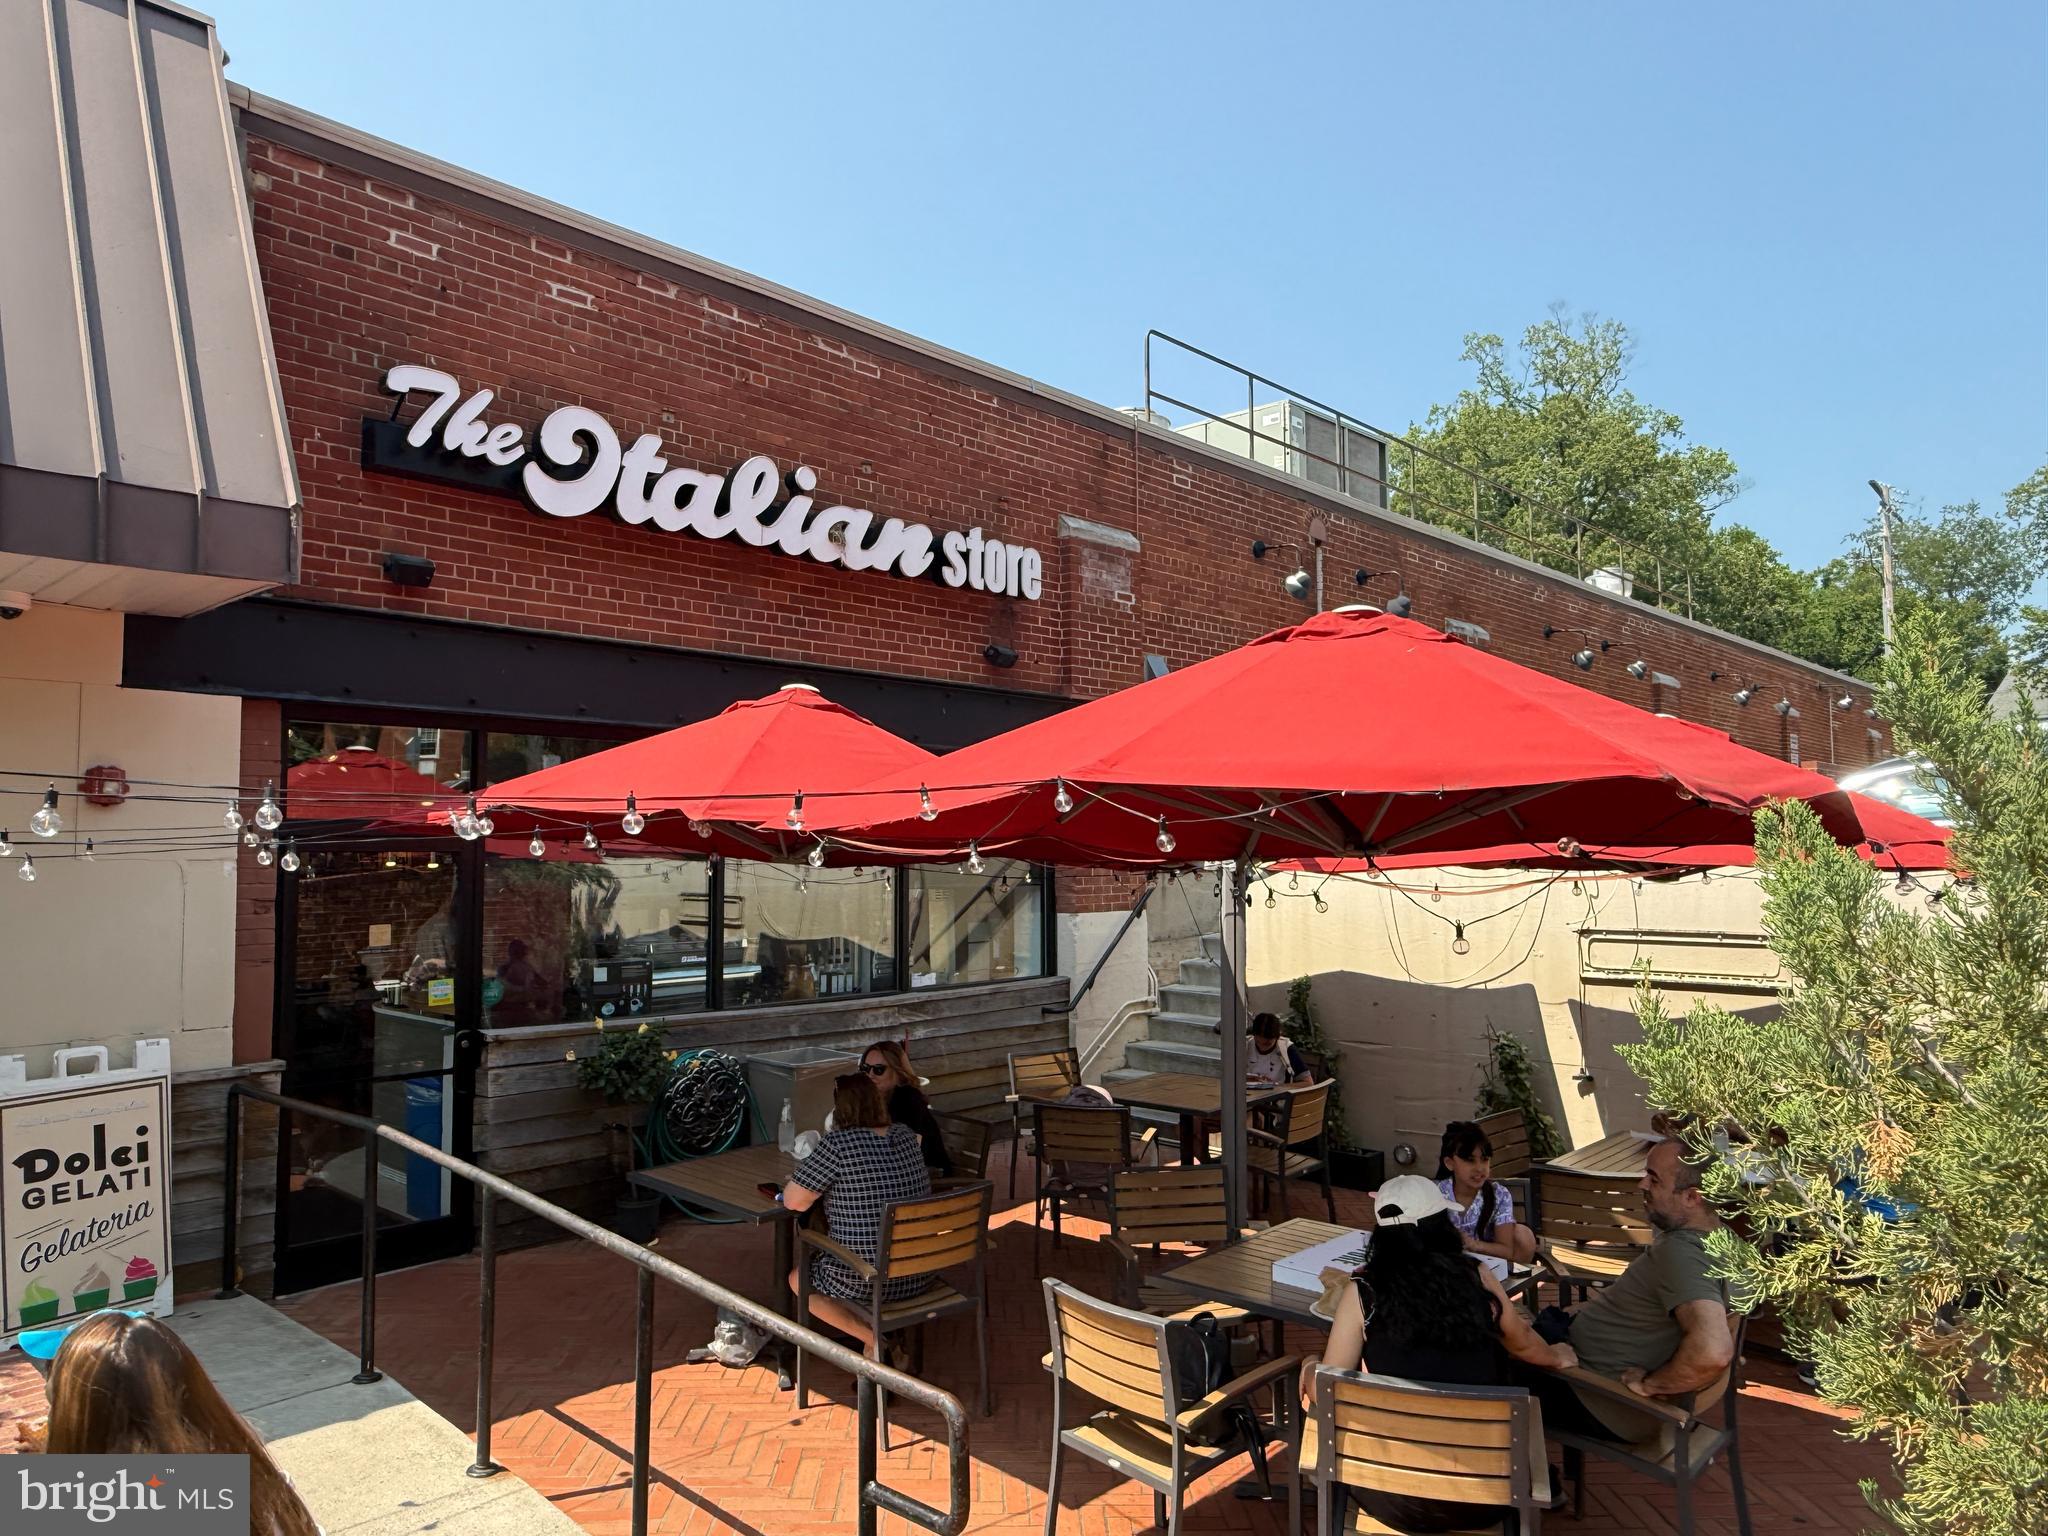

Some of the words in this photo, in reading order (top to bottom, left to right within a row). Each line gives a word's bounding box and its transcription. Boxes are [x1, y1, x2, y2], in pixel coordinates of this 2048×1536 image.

[387, 364, 526, 466] The
[522, 405, 935, 578] Italian
[942, 526, 1043, 601] store
[12, 1123, 149, 1185] Dolci
[21, 1166, 151, 1210] GELATI
[20, 1200, 154, 1273] Gelateria
